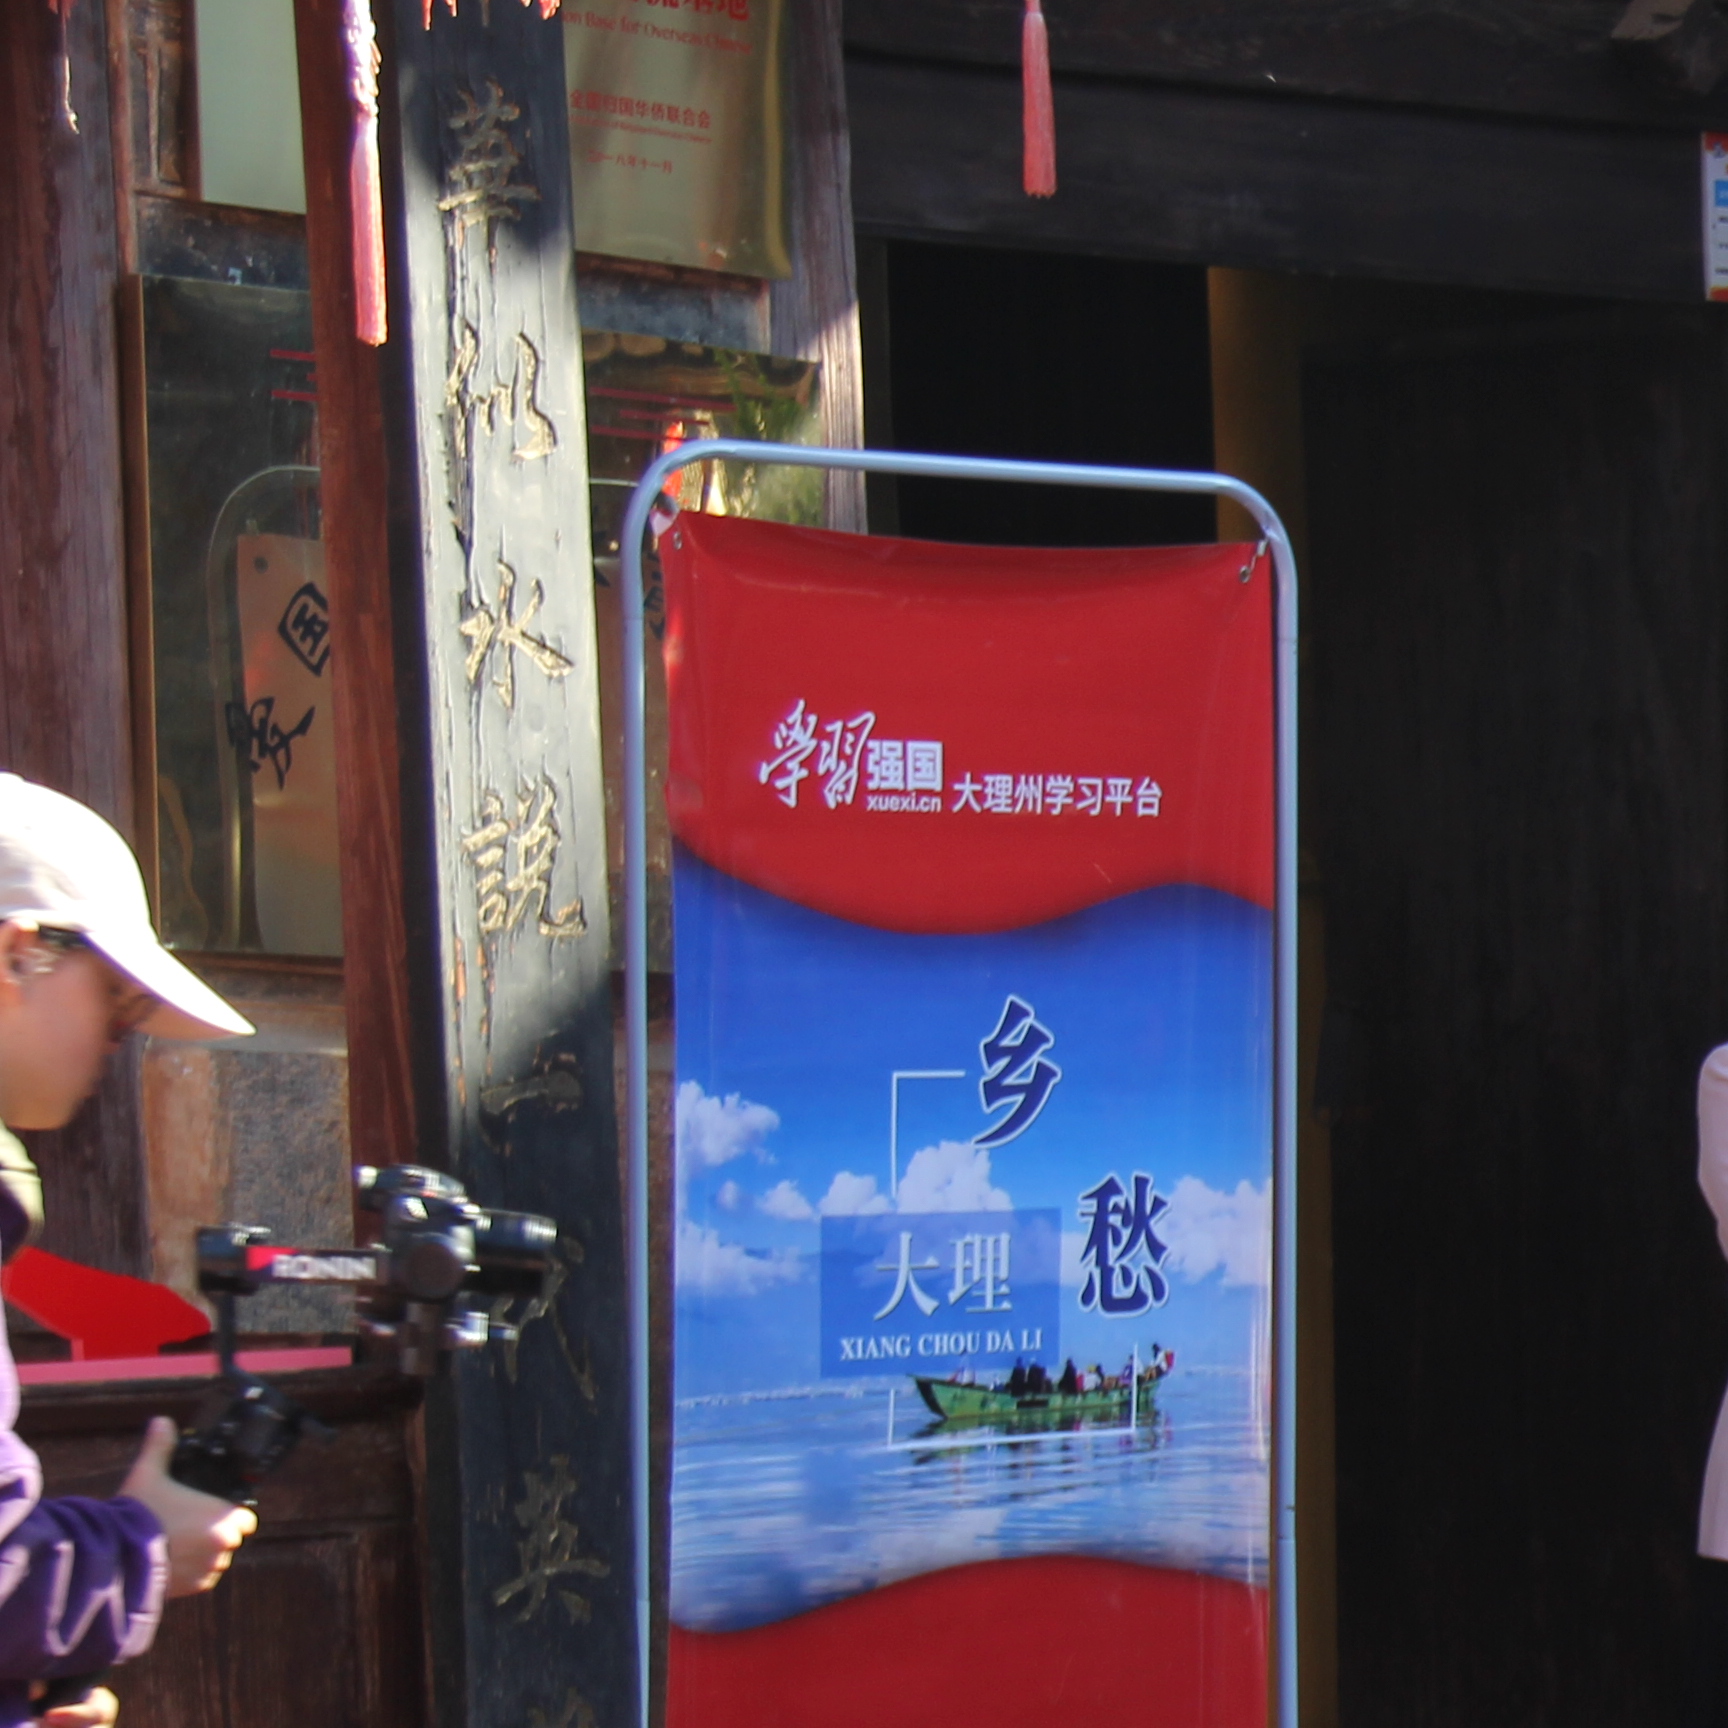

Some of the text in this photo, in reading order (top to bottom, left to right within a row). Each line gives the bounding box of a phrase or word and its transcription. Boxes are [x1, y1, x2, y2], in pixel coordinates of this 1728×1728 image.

[867, 794, 942, 812] xuexi.cn
[952, 773, 1162, 818] 大理州学习平台
[872, 1228, 1013, 1322] 大理
[840, 1329, 1043, 1361] XIANG CHOU DA LI
